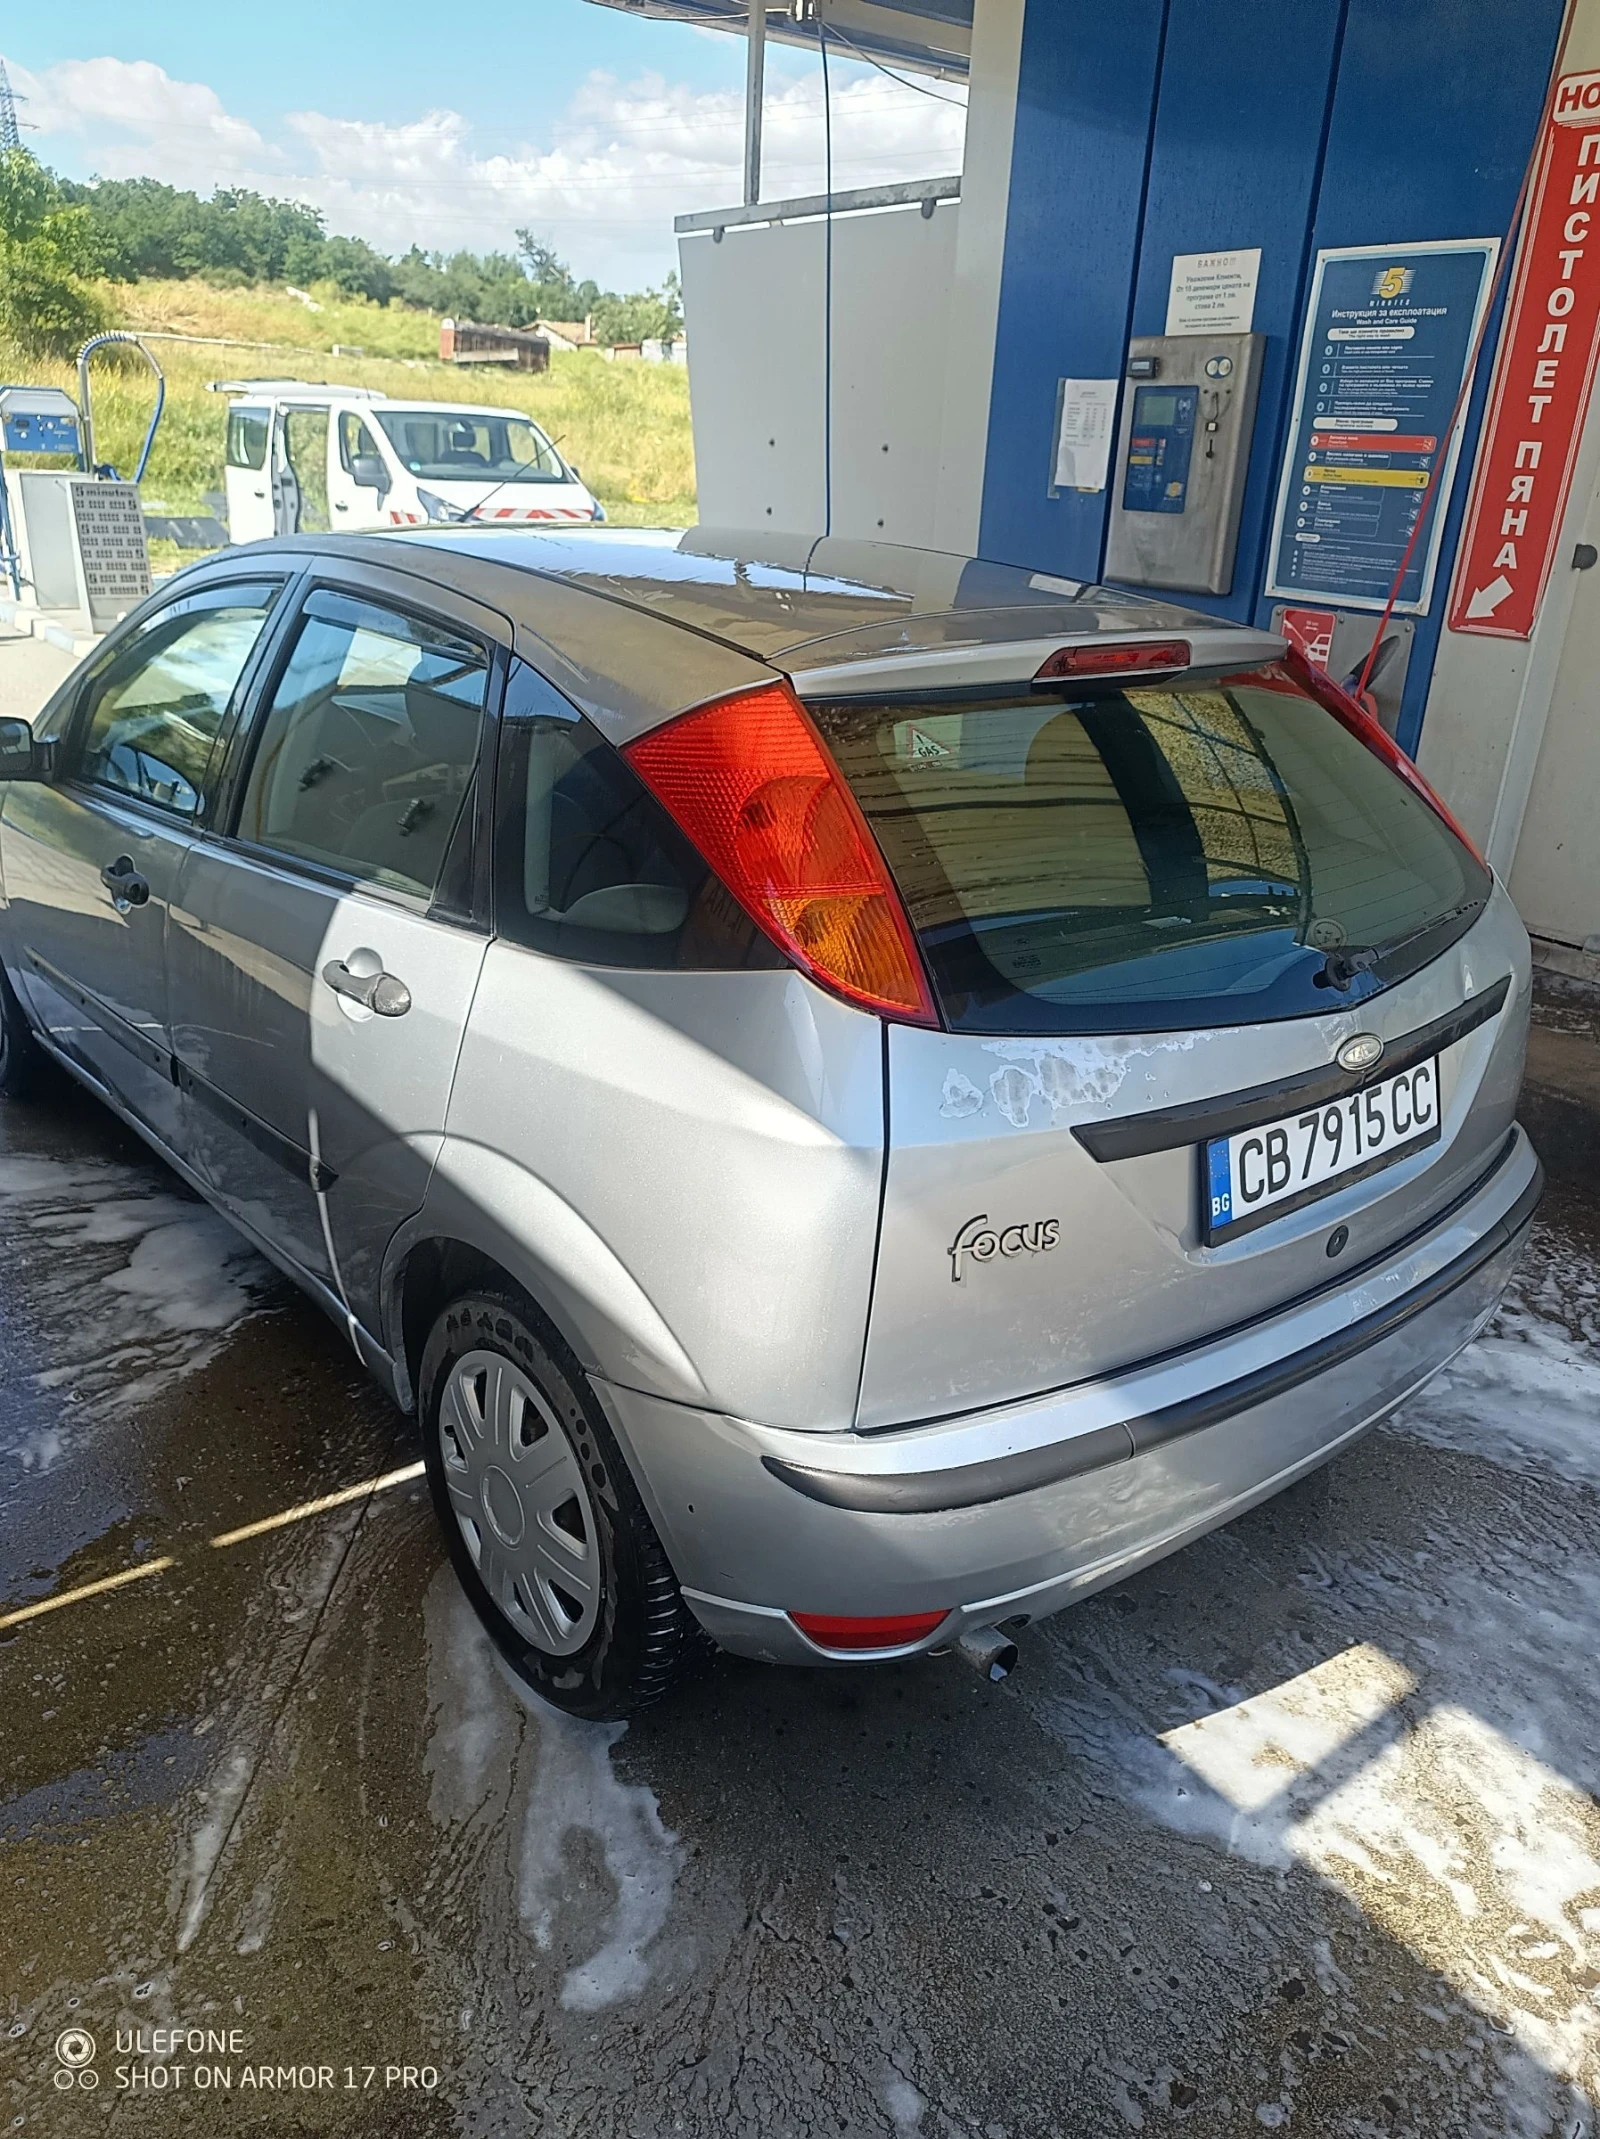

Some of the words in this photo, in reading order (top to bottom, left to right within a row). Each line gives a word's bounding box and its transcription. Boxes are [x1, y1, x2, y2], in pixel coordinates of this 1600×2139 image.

[1379, 266, 1406, 299] 5
[1528, 134, 1600, 423] ПИСТОЛЕТ
[1332, 309, 1377, 320] Инструкция
[1378, 309, 1388, 317] за
[1389, 307, 1448, 317] експлоатация
[1493, 441, 1542, 569] ПЯНА
[918, 745, 940, 758] GAS
[1212, 1192, 1230, 1216] BG
